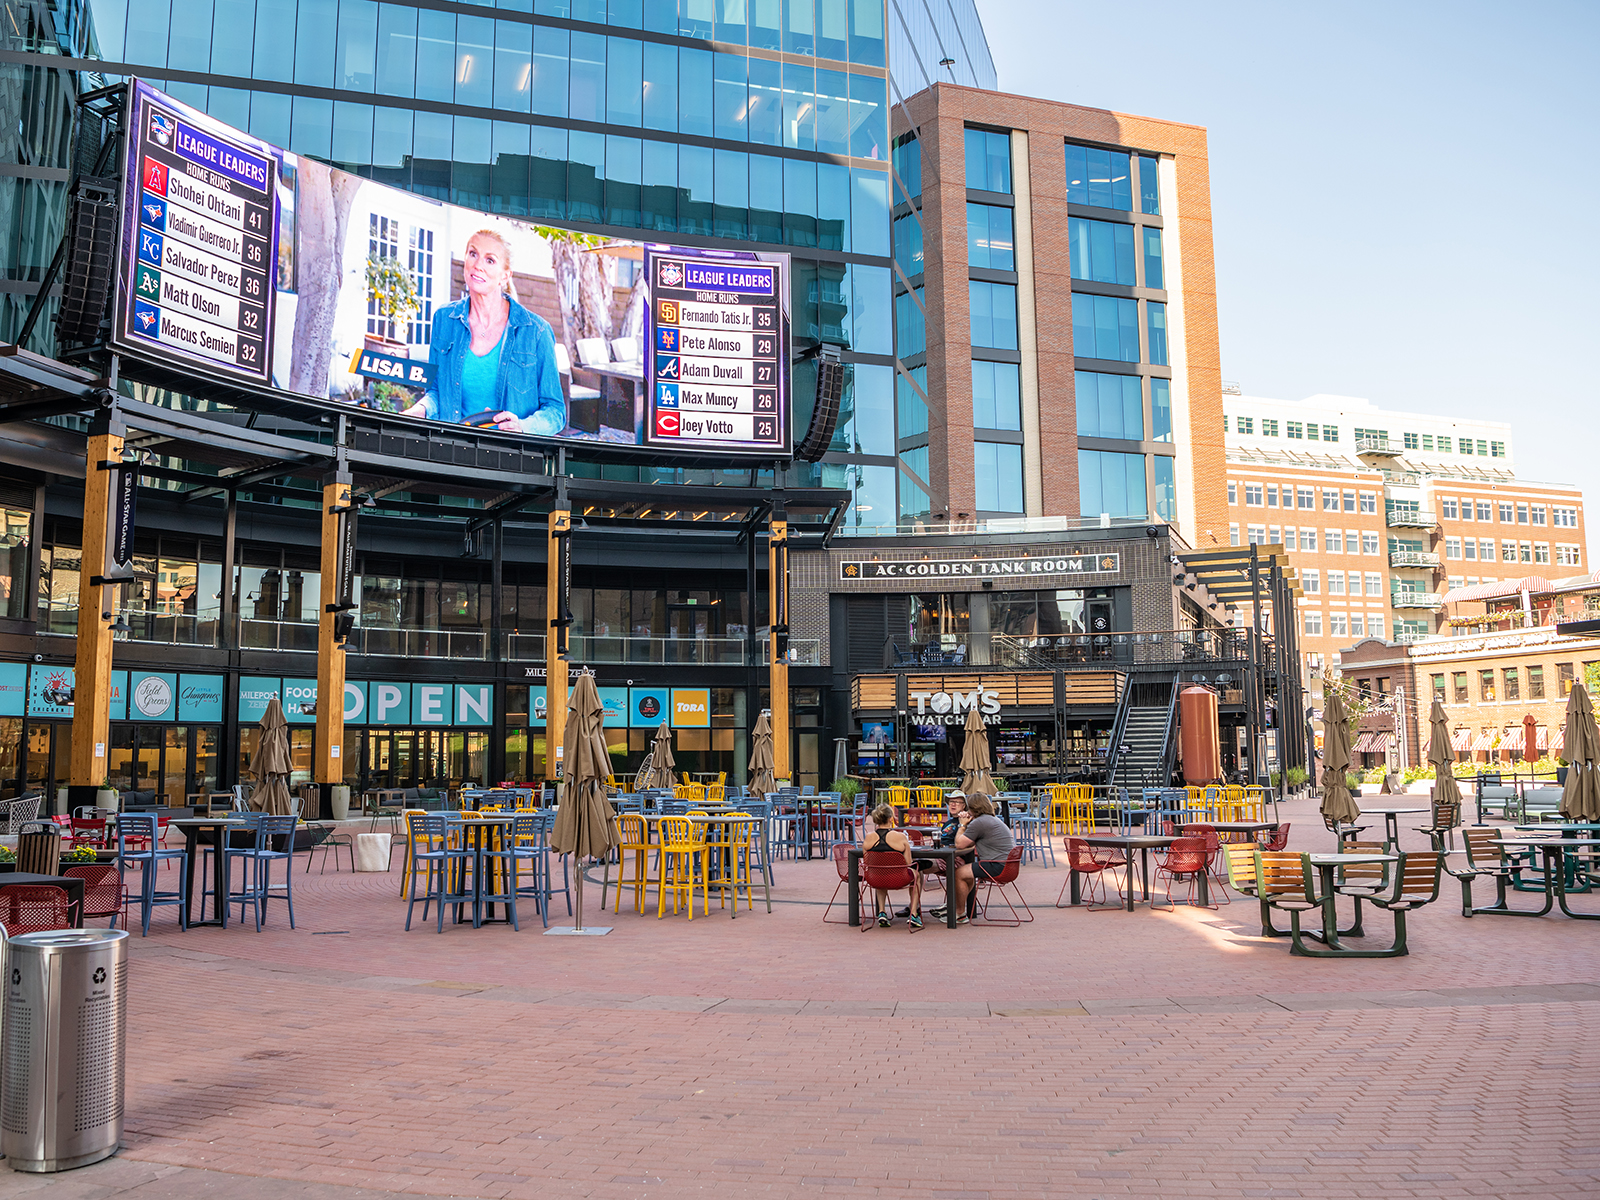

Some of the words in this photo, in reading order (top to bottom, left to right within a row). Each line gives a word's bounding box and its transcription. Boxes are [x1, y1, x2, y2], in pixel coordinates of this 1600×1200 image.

[178, 131, 217, 163] LEAGUE
[219, 150, 265, 183] LEADERS
[186, 162, 208, 183] HOME
[209, 172, 231, 192] RUNS
[170, 177, 205, 203] Shohei
[207, 194, 241, 221] Ohtani
[249, 211, 262, 229] 41
[168, 211, 197, 240] Vladimir
[199, 224, 231, 251] Guerrero
[232, 237, 241, 255] Jr.
[247, 244, 261, 262] 36
[165, 247, 208, 277] Salvador
[211, 264, 239, 288] Perez
[245, 279, 260, 296] 36
[687, 270, 725, 286] LEAGUE
[727, 273, 771, 288] LEADERS
[163, 282, 189, 306] Matt
[192, 292, 220, 317] Olson
[243, 311, 258, 329] 32
[696, 292, 718, 303] HOME
[719, 293, 739, 304] RUNS
[682, 307, 719, 323] Fernando
[721, 311, 741, 325] Tatis
[742, 312, 752, 325] Jr.
[758, 313, 771, 327] 35
[161, 317, 197, 344] Marcus
[200, 330, 235, 356] Semien
[241, 344, 256, 362] 32
[682, 335, 705, 349] Pete
[708, 337, 741, 352] Alonso
[758, 340, 771, 353] 29
[361, 355, 404, 379] LISA
[409, 366, 428, 383] B.
[682, 363, 710, 377] Adam
[713, 365, 743, 379] Duvall
[758, 367, 771, 381] 27
[682, 390, 703, 405] Max
[706, 391, 738, 409] Muncy
[758, 395, 772, 408] 26
[681, 418, 703, 435] Joey
[706, 420, 733, 434] Votto
[758, 422, 772, 436] 25
[120, 525, 128, 550] GAME
[875, 564, 897, 575] AC
[905, 563, 973, 575] GOLDEN
[979, 562, 1026, 574] TANK
[1031, 559, 1083, 572] ROOM
[140, 683, 163, 696] Field
[240, 691, 275, 700] MILEPOS
[143, 694, 168, 709] Greens
[676, 702, 705, 712] TORA
[911, 715, 965, 725] WATCH
[982, 714, 1002, 725] AR
